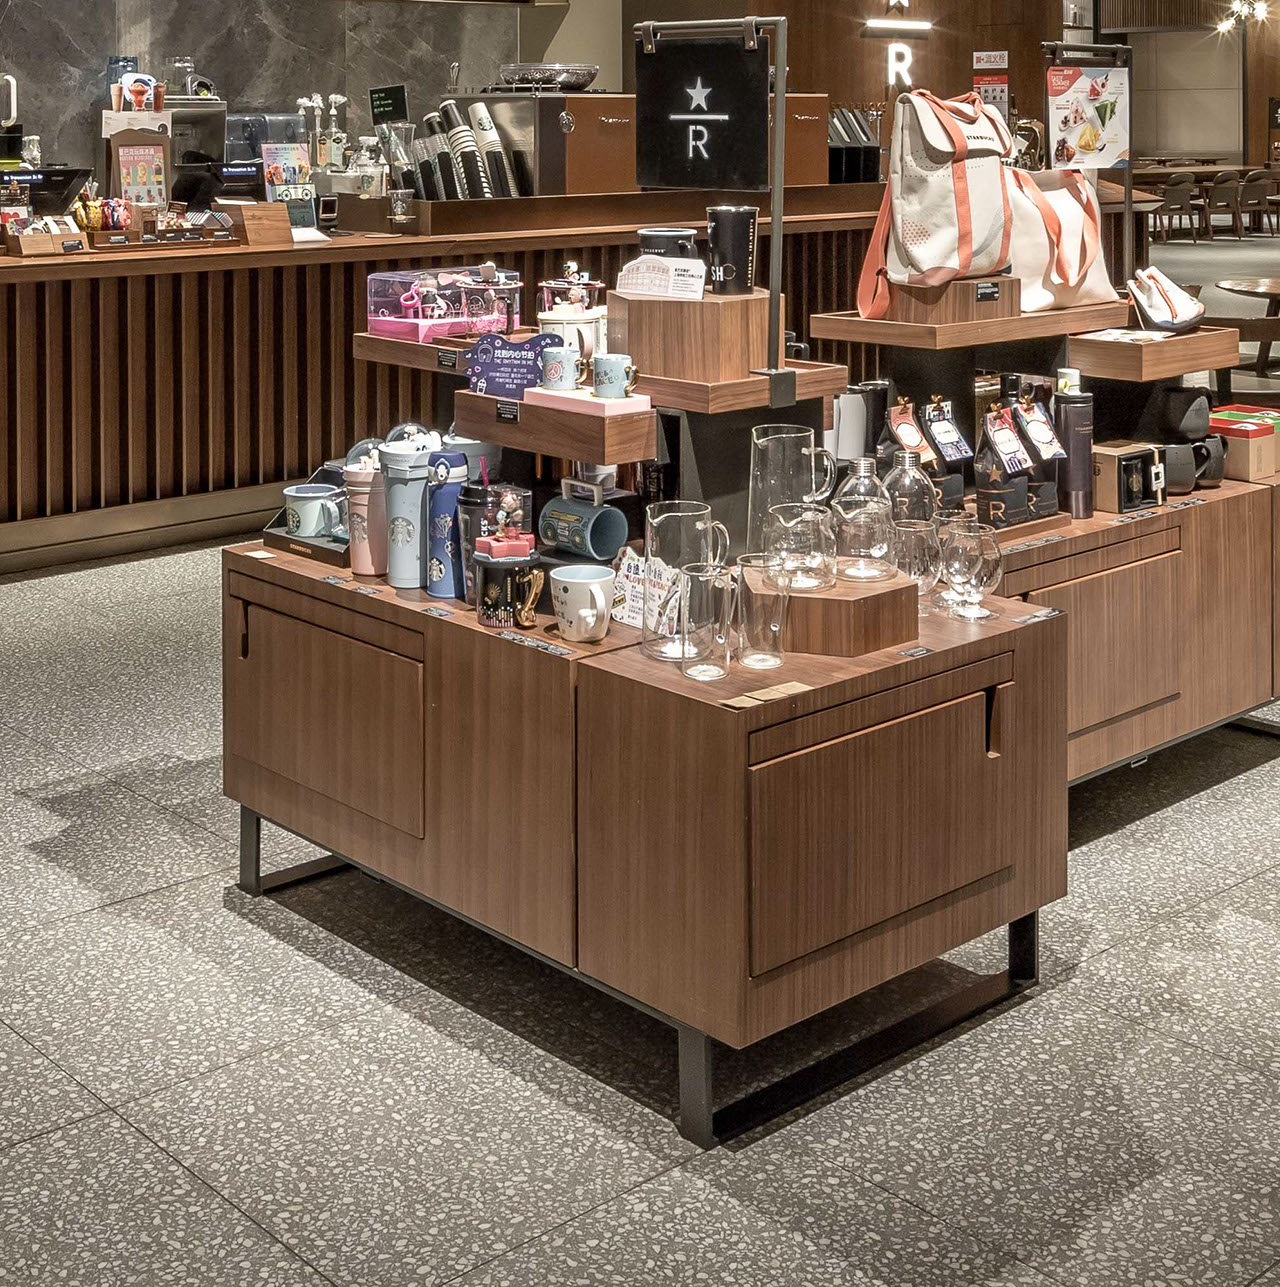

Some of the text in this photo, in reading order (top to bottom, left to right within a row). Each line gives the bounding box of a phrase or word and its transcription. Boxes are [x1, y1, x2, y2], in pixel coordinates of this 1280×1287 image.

[888, 42, 912, 86] R
[688, 124, 709, 160] R
[966, 134, 995, 142] STARBUCKS
[494, 349, 534, 359] 找到内心节拍
[989, 501, 1006, 520] R
[290, 543, 312, 554] STARBUCKS
